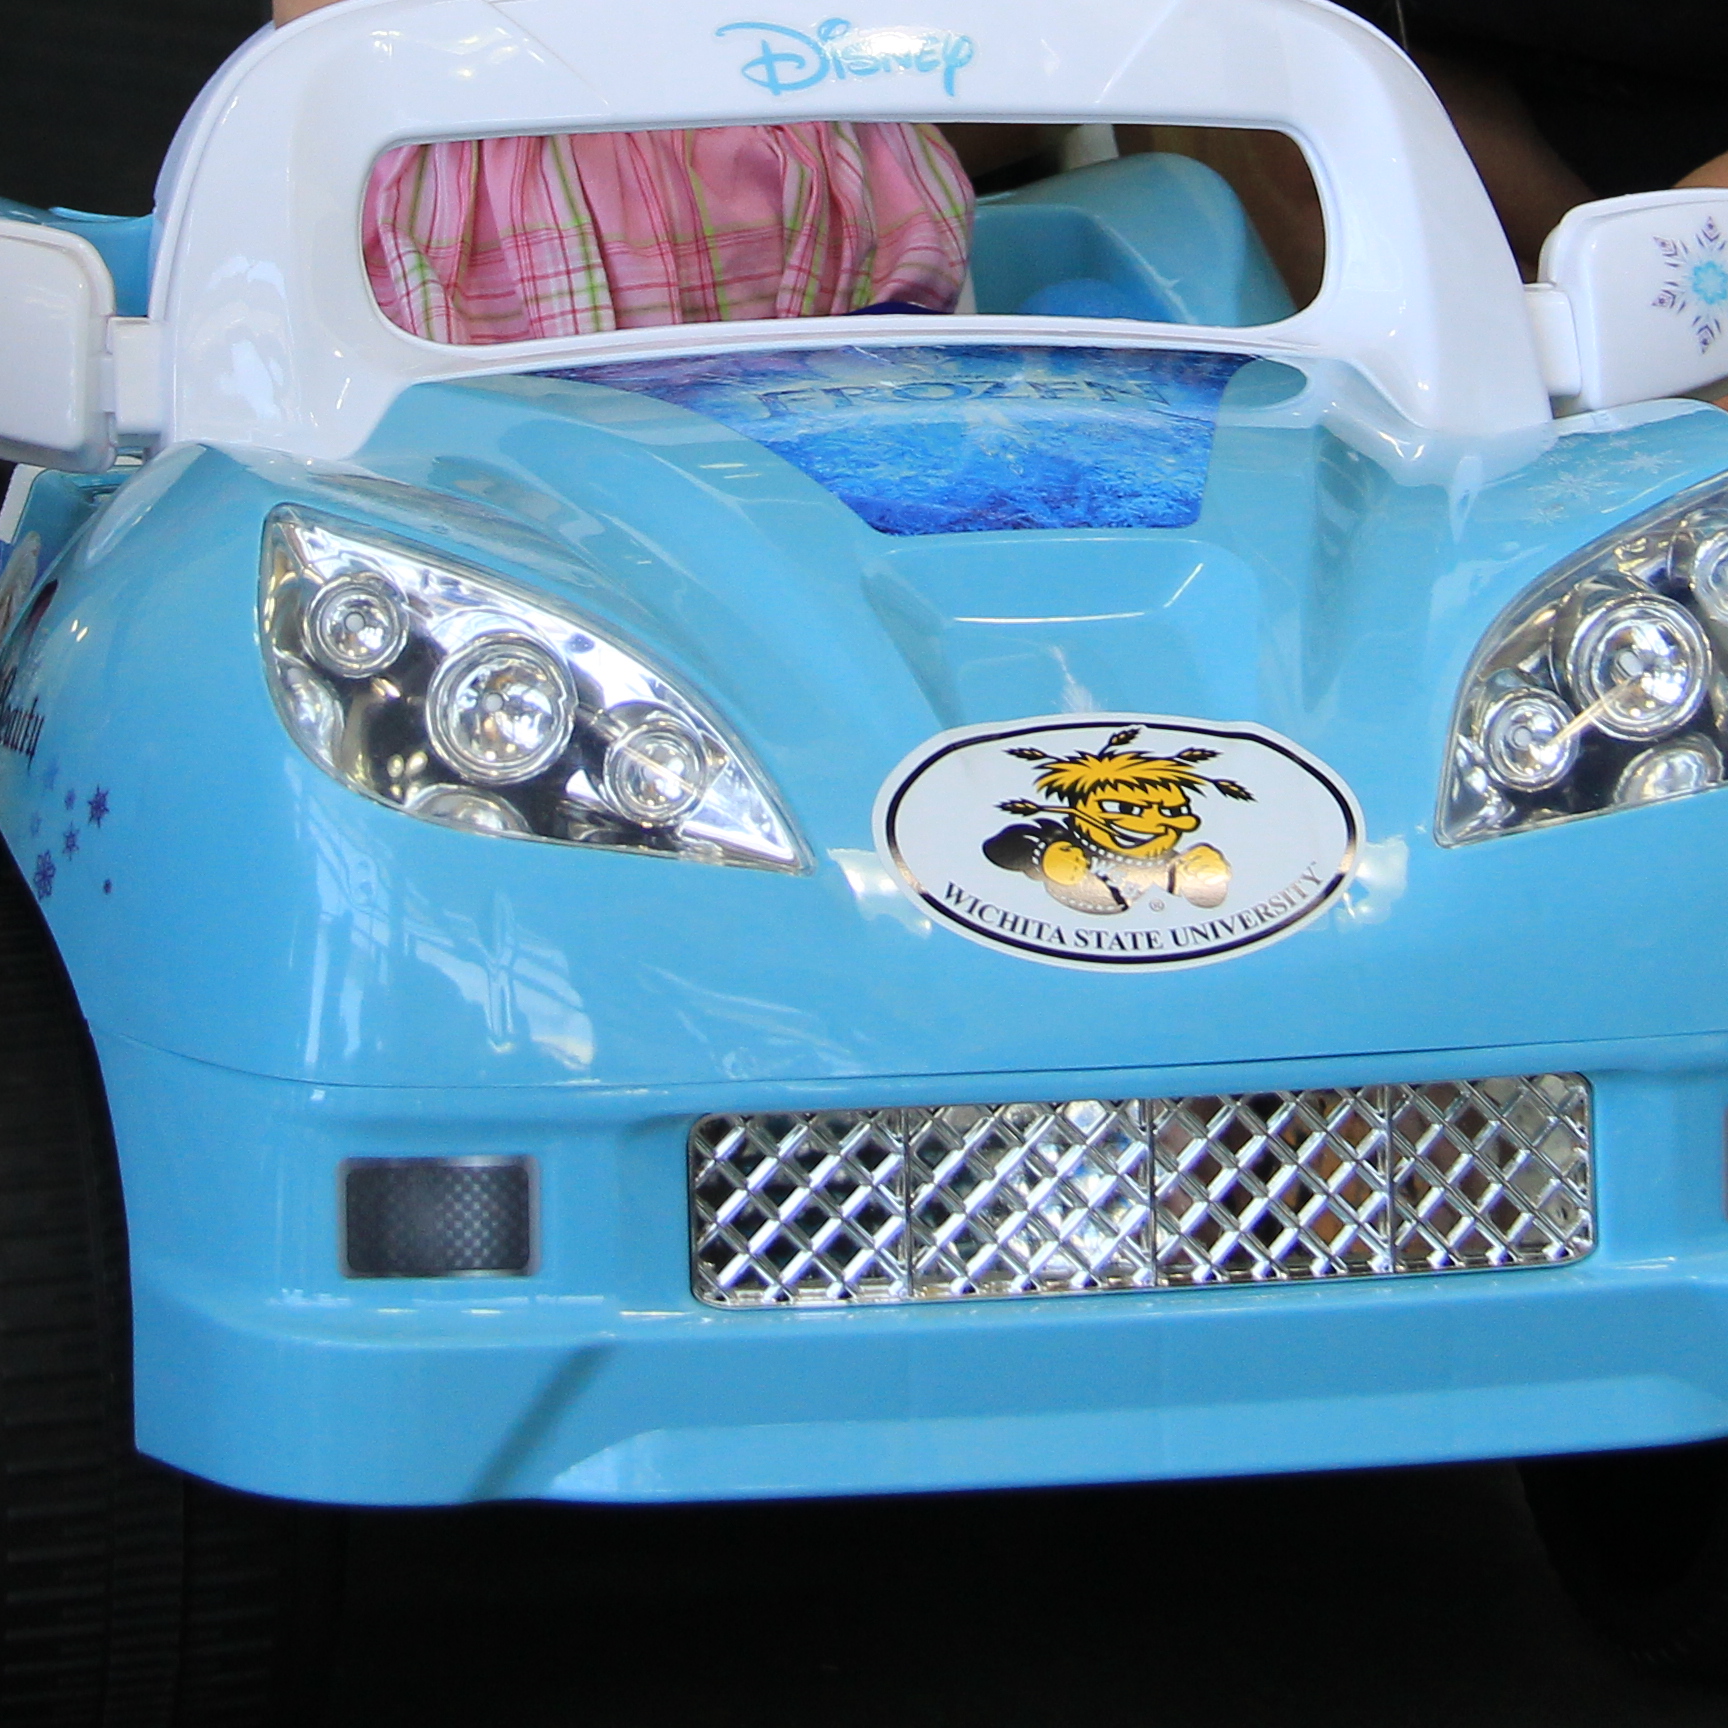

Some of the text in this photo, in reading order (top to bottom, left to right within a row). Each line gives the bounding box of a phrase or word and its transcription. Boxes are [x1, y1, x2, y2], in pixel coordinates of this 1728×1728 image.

[715, 17, 974, 97] Disney
[756, 378, 1170, 419] FROZEN
[944, 864, 1324, 952] WICHITA STATE UNIVERSITY
